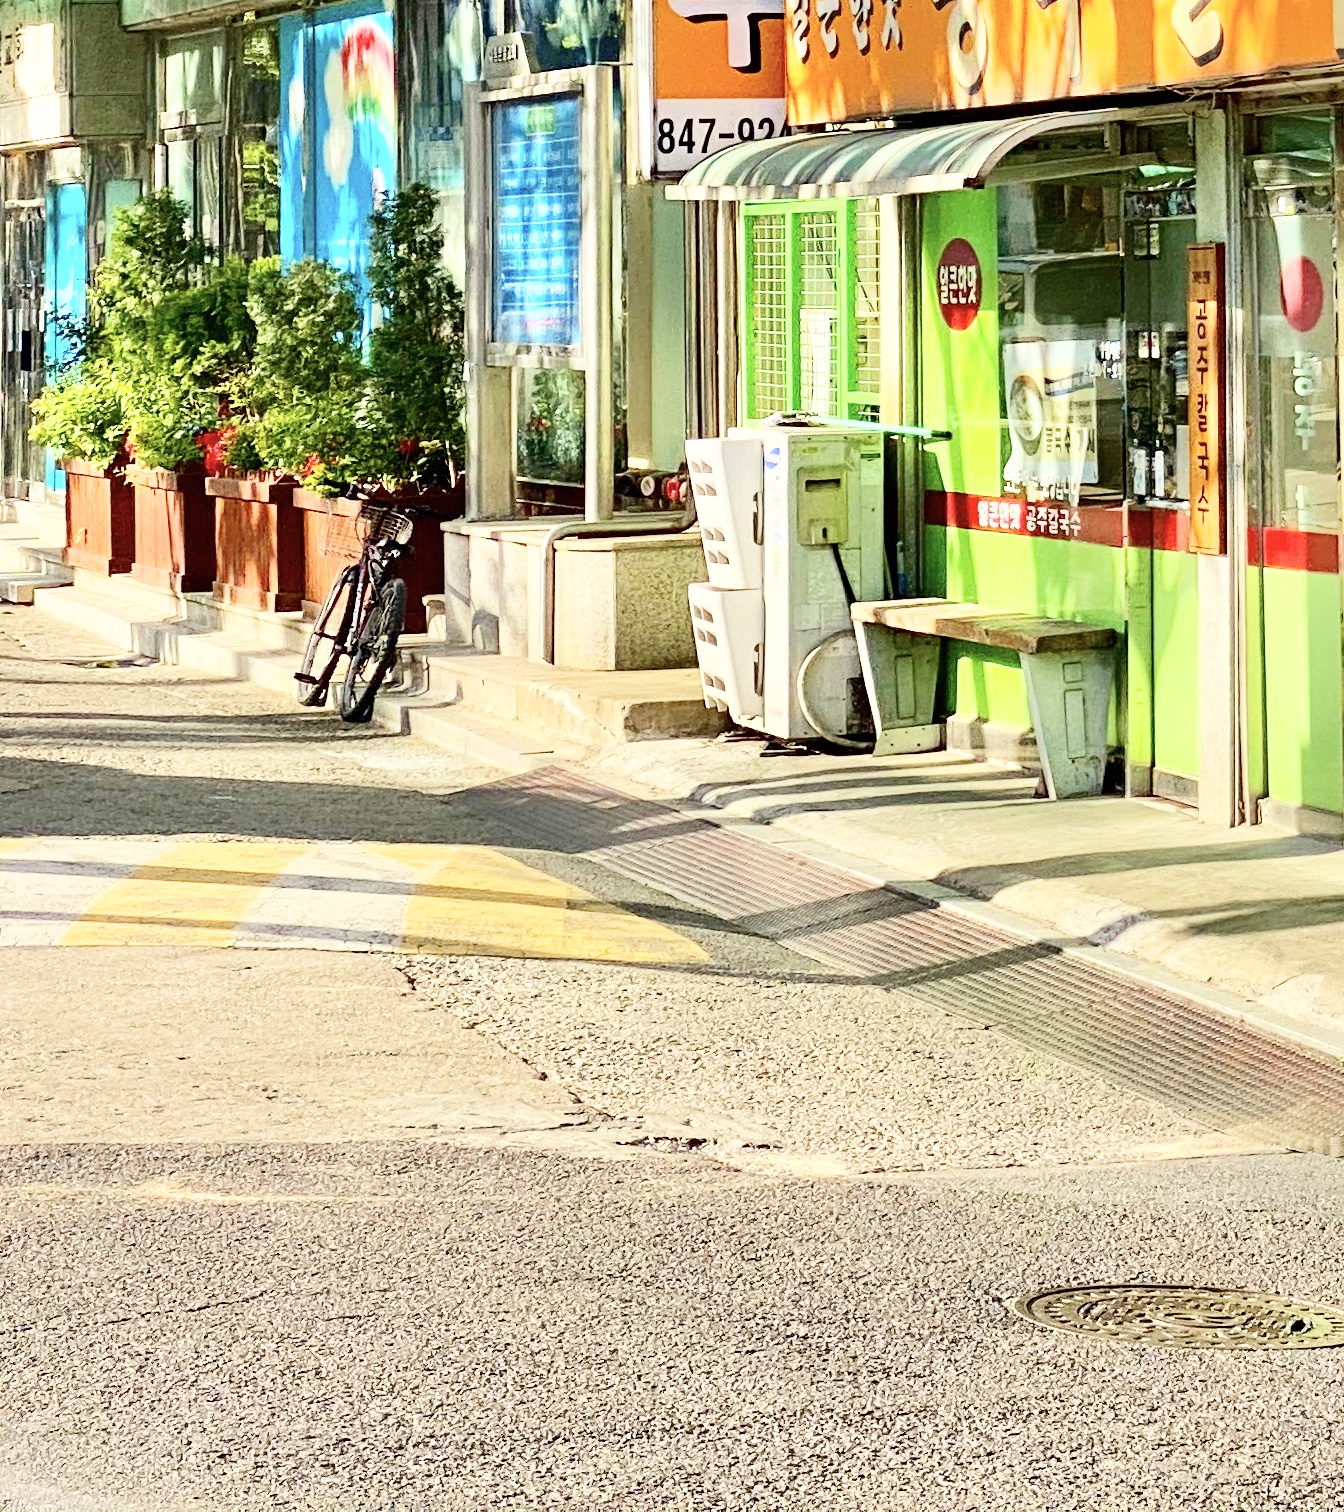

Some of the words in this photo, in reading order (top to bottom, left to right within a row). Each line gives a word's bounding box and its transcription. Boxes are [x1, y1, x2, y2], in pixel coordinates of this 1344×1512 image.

[1195, 299, 1210, 524] 공주칼국수
[976, 500, 1021, 530] 얼큰한맛
[1025, 504, 1082, 537] 공주칼국수
